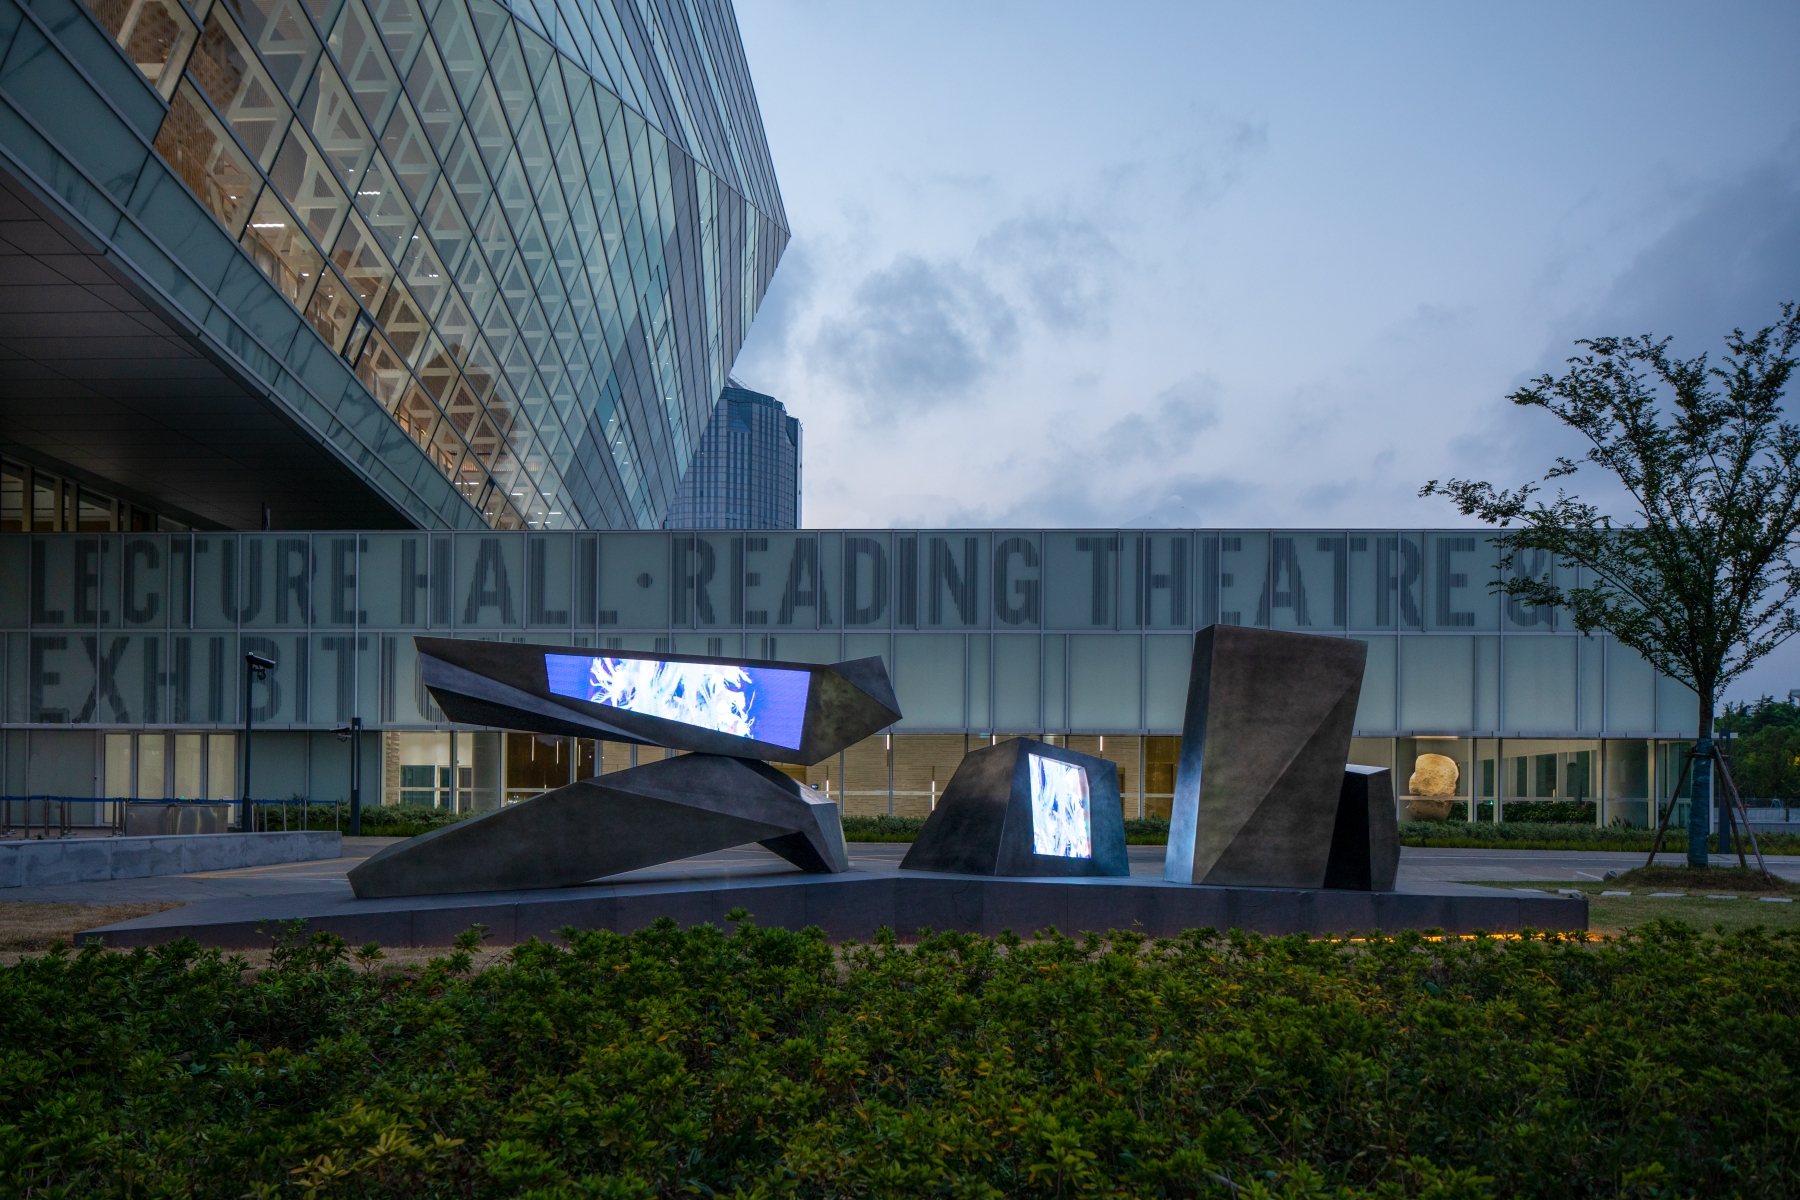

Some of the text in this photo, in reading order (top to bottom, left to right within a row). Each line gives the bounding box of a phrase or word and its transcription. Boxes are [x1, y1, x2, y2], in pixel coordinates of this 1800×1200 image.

[32, 538, 367, 625] LECTURE
[402, 538, 617, 625] HALL
[672, 537, 1039, 625] READING
[1076, 537, 1476, 626] THEATRE
[30, 636, 526, 724] EXHIBITI
